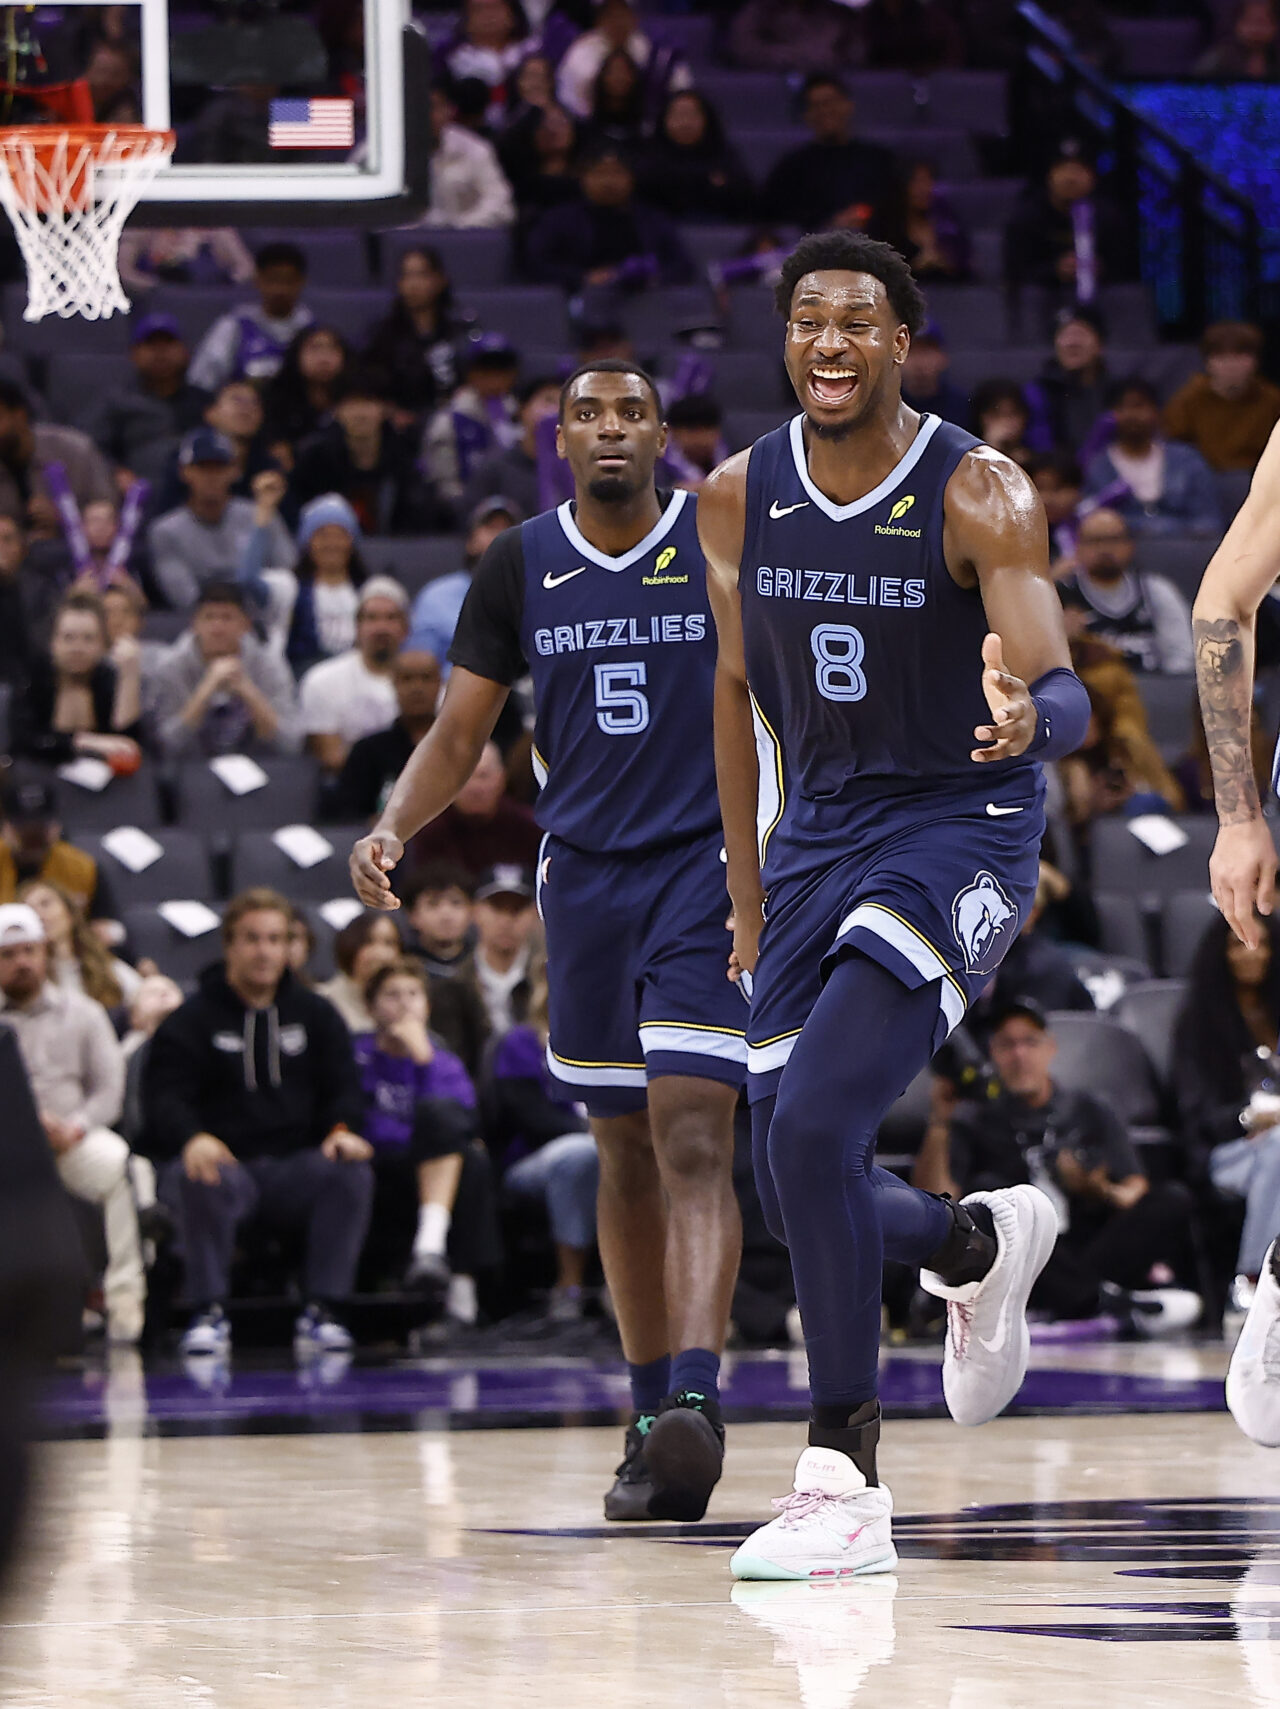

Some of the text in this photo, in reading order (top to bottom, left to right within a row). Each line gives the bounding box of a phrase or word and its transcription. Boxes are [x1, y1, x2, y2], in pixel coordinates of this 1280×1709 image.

[874, 525, 921, 538] Robinhood
[642, 574, 688, 586] Robinhood
[756, 566, 926, 608] GRIZZLIES
[534, 614, 706, 656] GRIZZLIES
[810, 623, 867, 702] 8
[594, 661, 649, 735] 5
